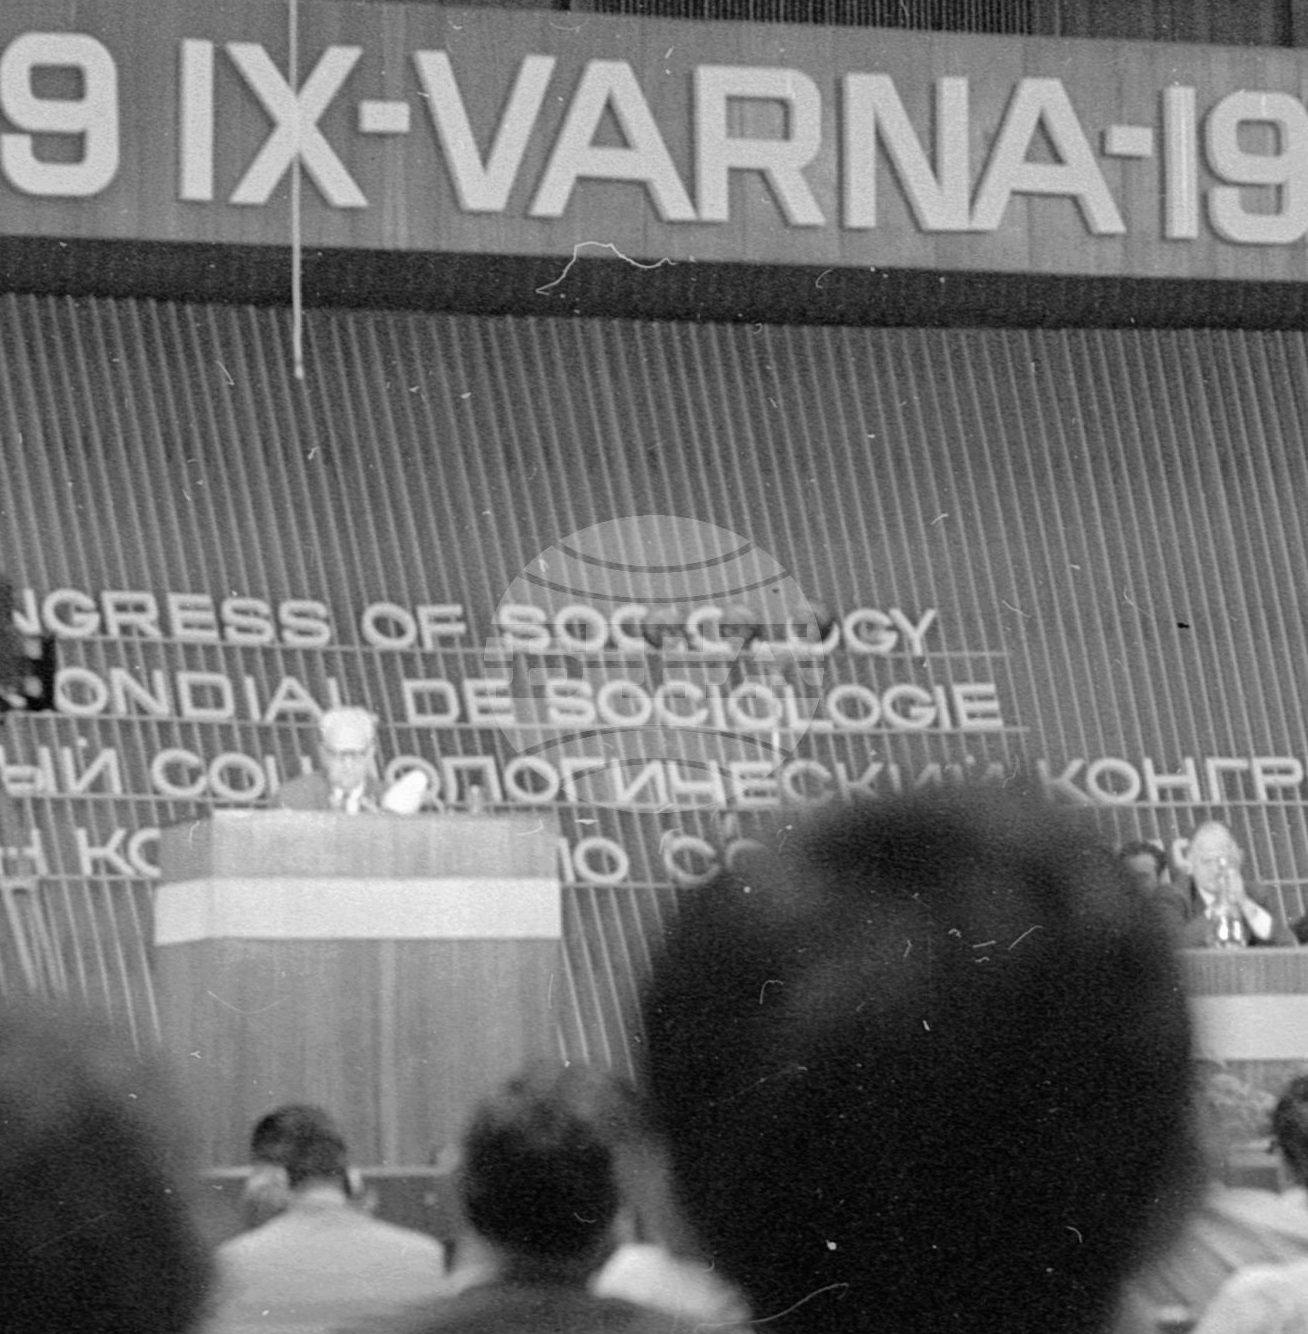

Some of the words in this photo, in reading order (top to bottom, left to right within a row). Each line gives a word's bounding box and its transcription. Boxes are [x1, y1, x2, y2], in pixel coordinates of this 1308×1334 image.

[360, 602, 467, 650] OF
[498, 603, 936, 657] SOCOOGY
[52, 666, 344, 725] ONDIA
[402, 677, 515, 728] DE
[545, 678, 1004, 731] SOCIOLOGIE
